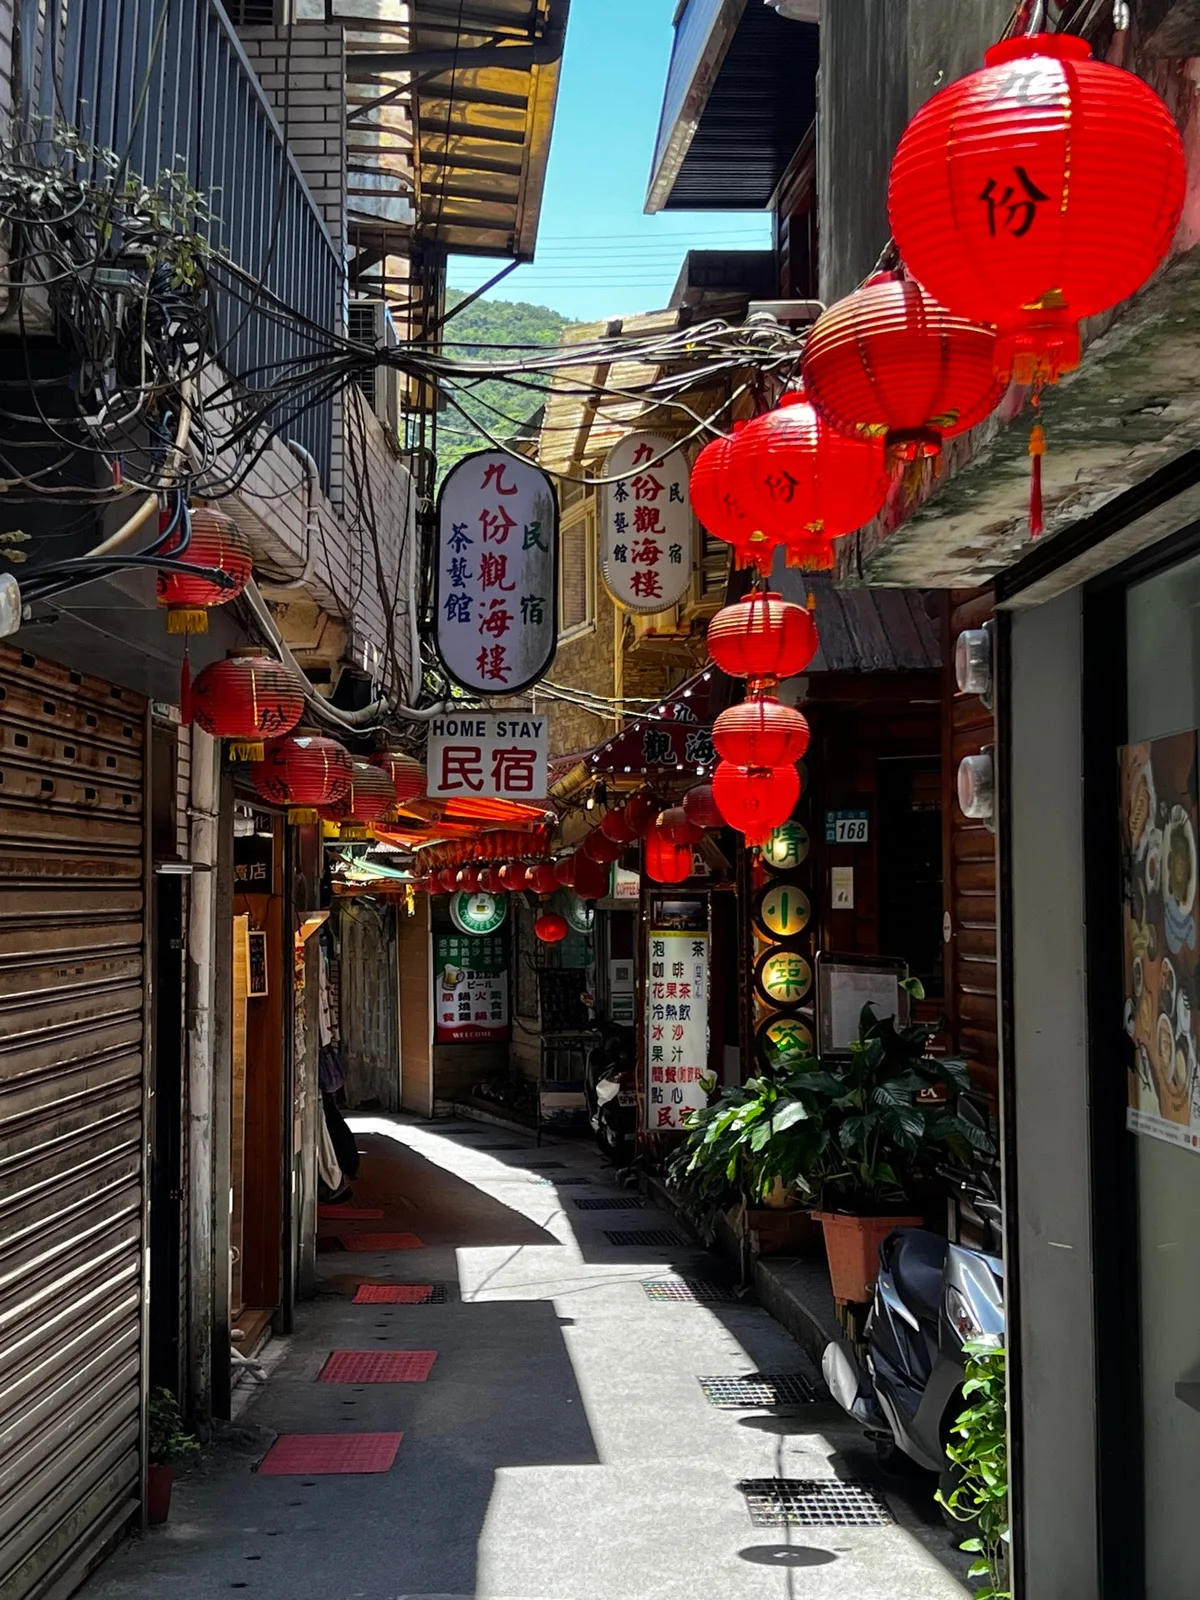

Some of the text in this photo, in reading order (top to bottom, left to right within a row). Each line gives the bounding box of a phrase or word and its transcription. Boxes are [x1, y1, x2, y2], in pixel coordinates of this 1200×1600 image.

[613, 482, 630, 564] 茶藝館
[630, 442, 666, 599] 九份觀海樓
[669, 482, 684, 564] 民宿
[443, 524, 474, 624] 茶藝館
[476, 464, 519, 684] 九份觀海樓
[521, 522, 549, 625] 民宿
[433, 720, 543, 738] HOME STAY
[437, 746, 538, 792] 民宿
[839, 822, 865, 840] 168
[652, 962, 685, 978] 咖啡
[467, 981, 493, 989] ビール
[652, 983, 691, 999] 花果茶
[652, 1004, 691, 1021] 冷熱飲
[452, 1030, 493, 1039] WELCOME
[652, 1024, 684, 1041] 冰沙
[652, 1046, 684, 1062] 果汁
[651, 1087, 683, 1104] 點心
